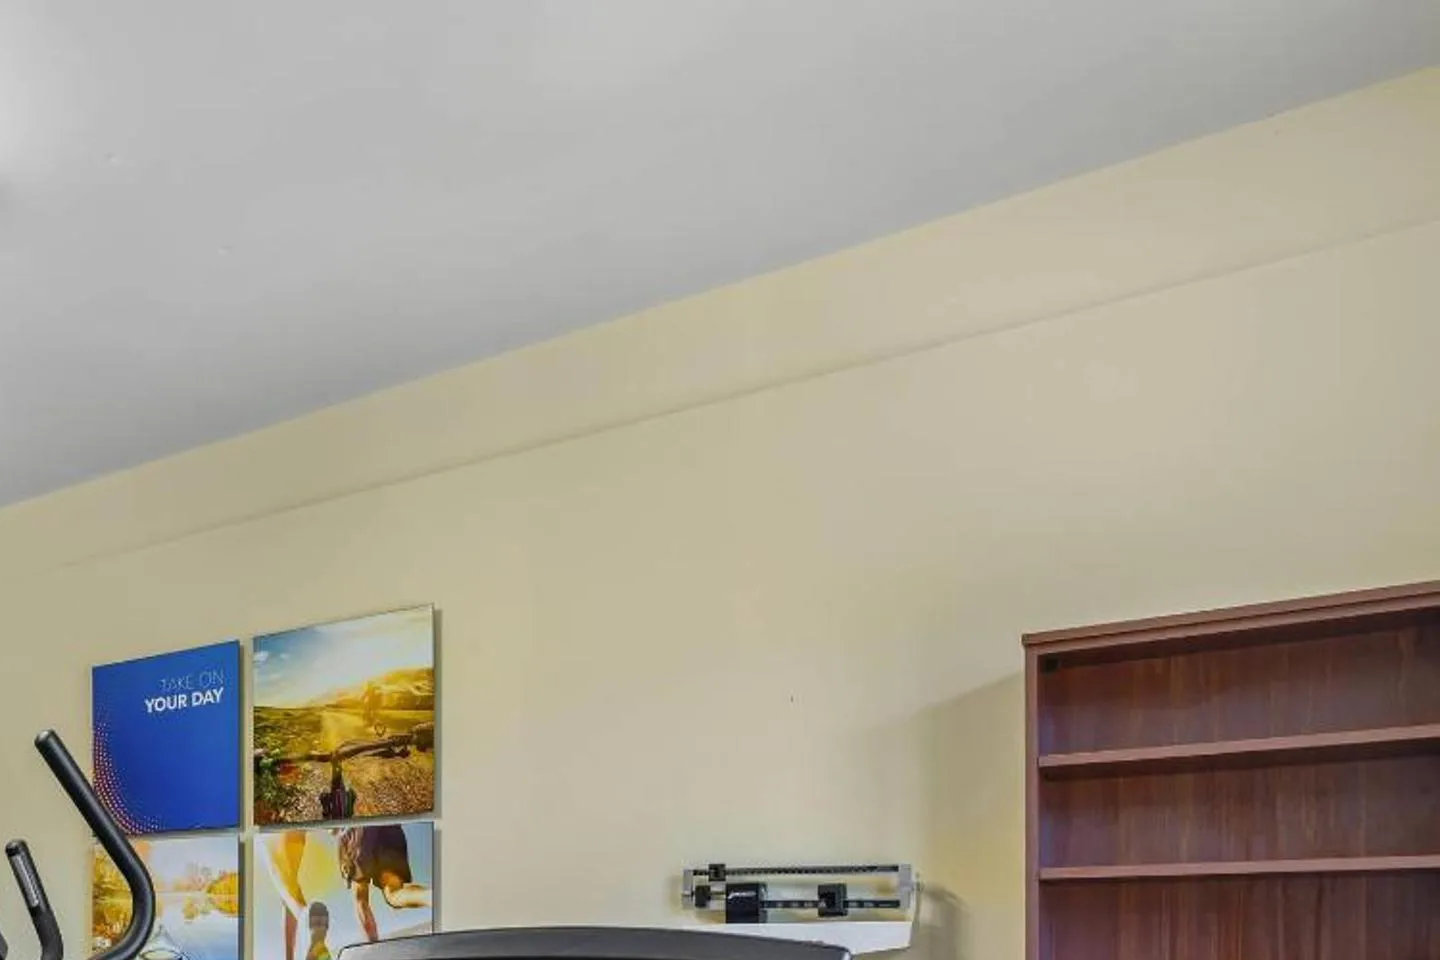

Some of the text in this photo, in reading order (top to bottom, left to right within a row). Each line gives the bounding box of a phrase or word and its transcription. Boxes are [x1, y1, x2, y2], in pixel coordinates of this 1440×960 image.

[161, 669, 224, 690] TAKE ON
[145, 687, 224, 713] YOUR DAY
